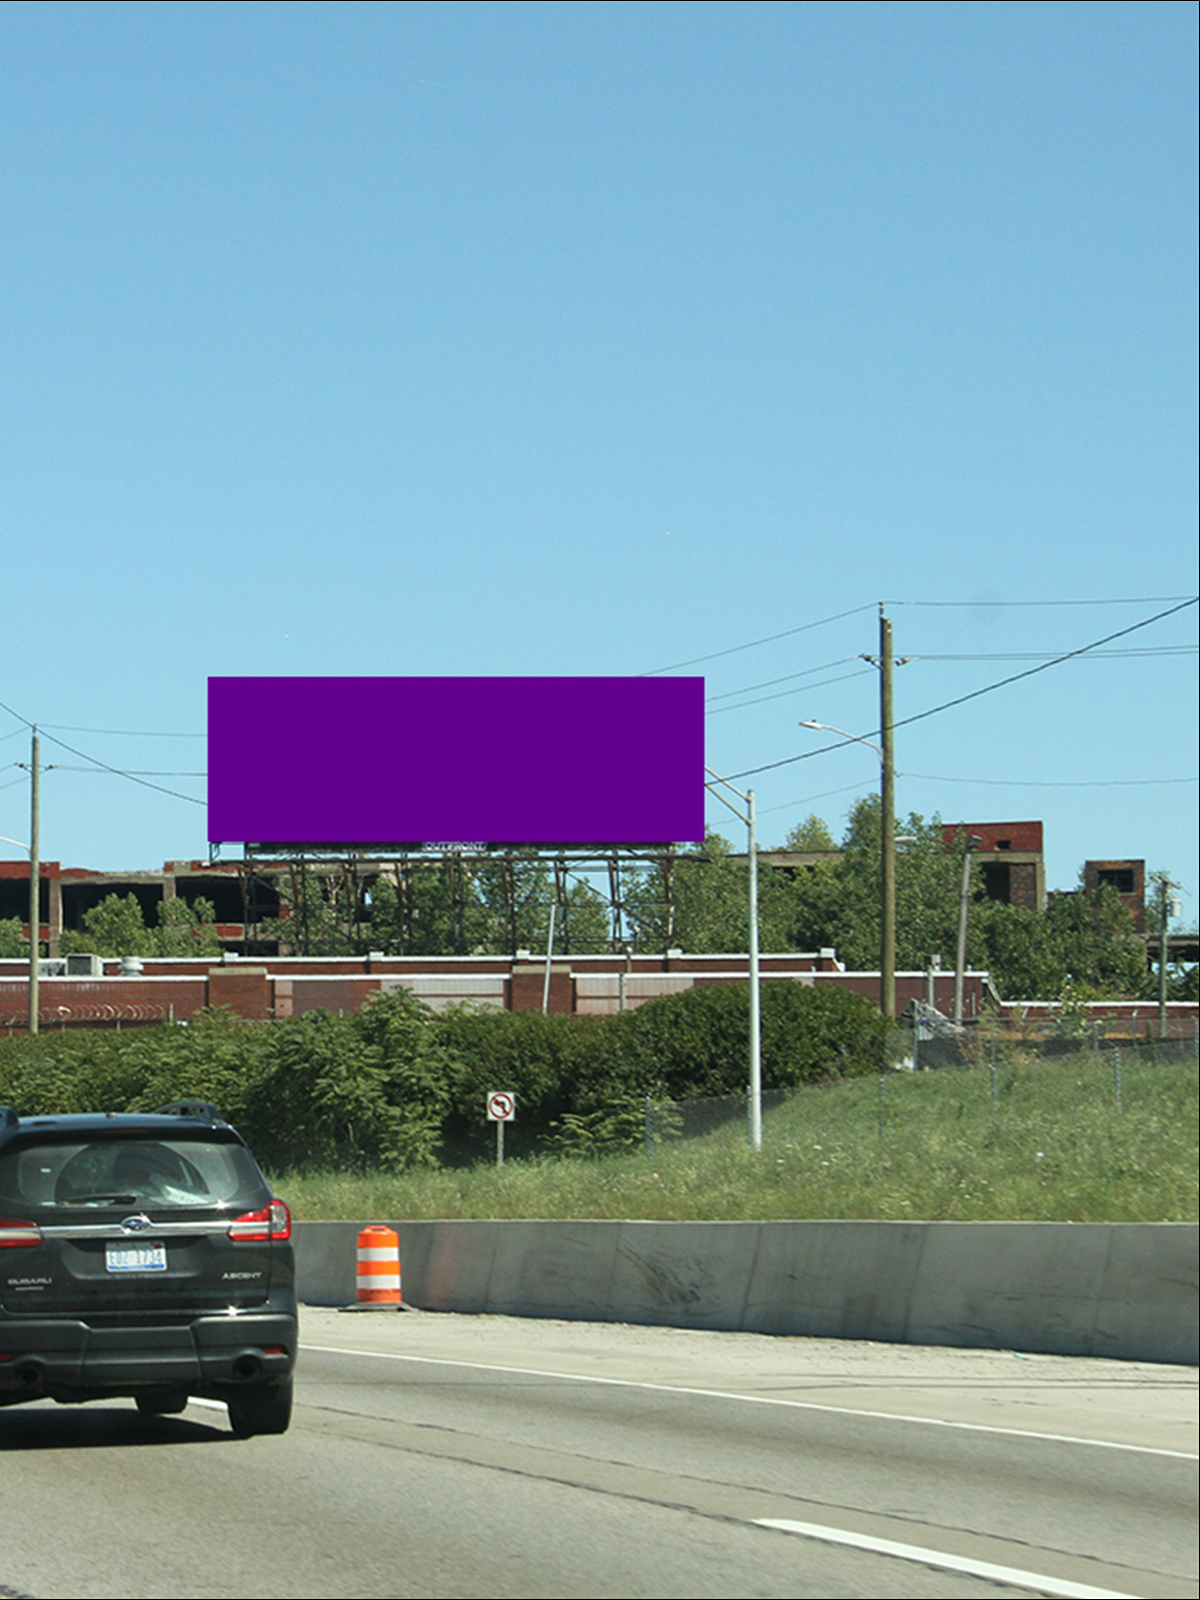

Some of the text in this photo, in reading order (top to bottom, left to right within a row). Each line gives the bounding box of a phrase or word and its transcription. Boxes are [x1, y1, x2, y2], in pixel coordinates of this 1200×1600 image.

[422, 841, 486, 852] OUTFRONT
[222, 1272, 262, 1280] ASCENT
[8, 1277, 52, 1285] SUBARU
